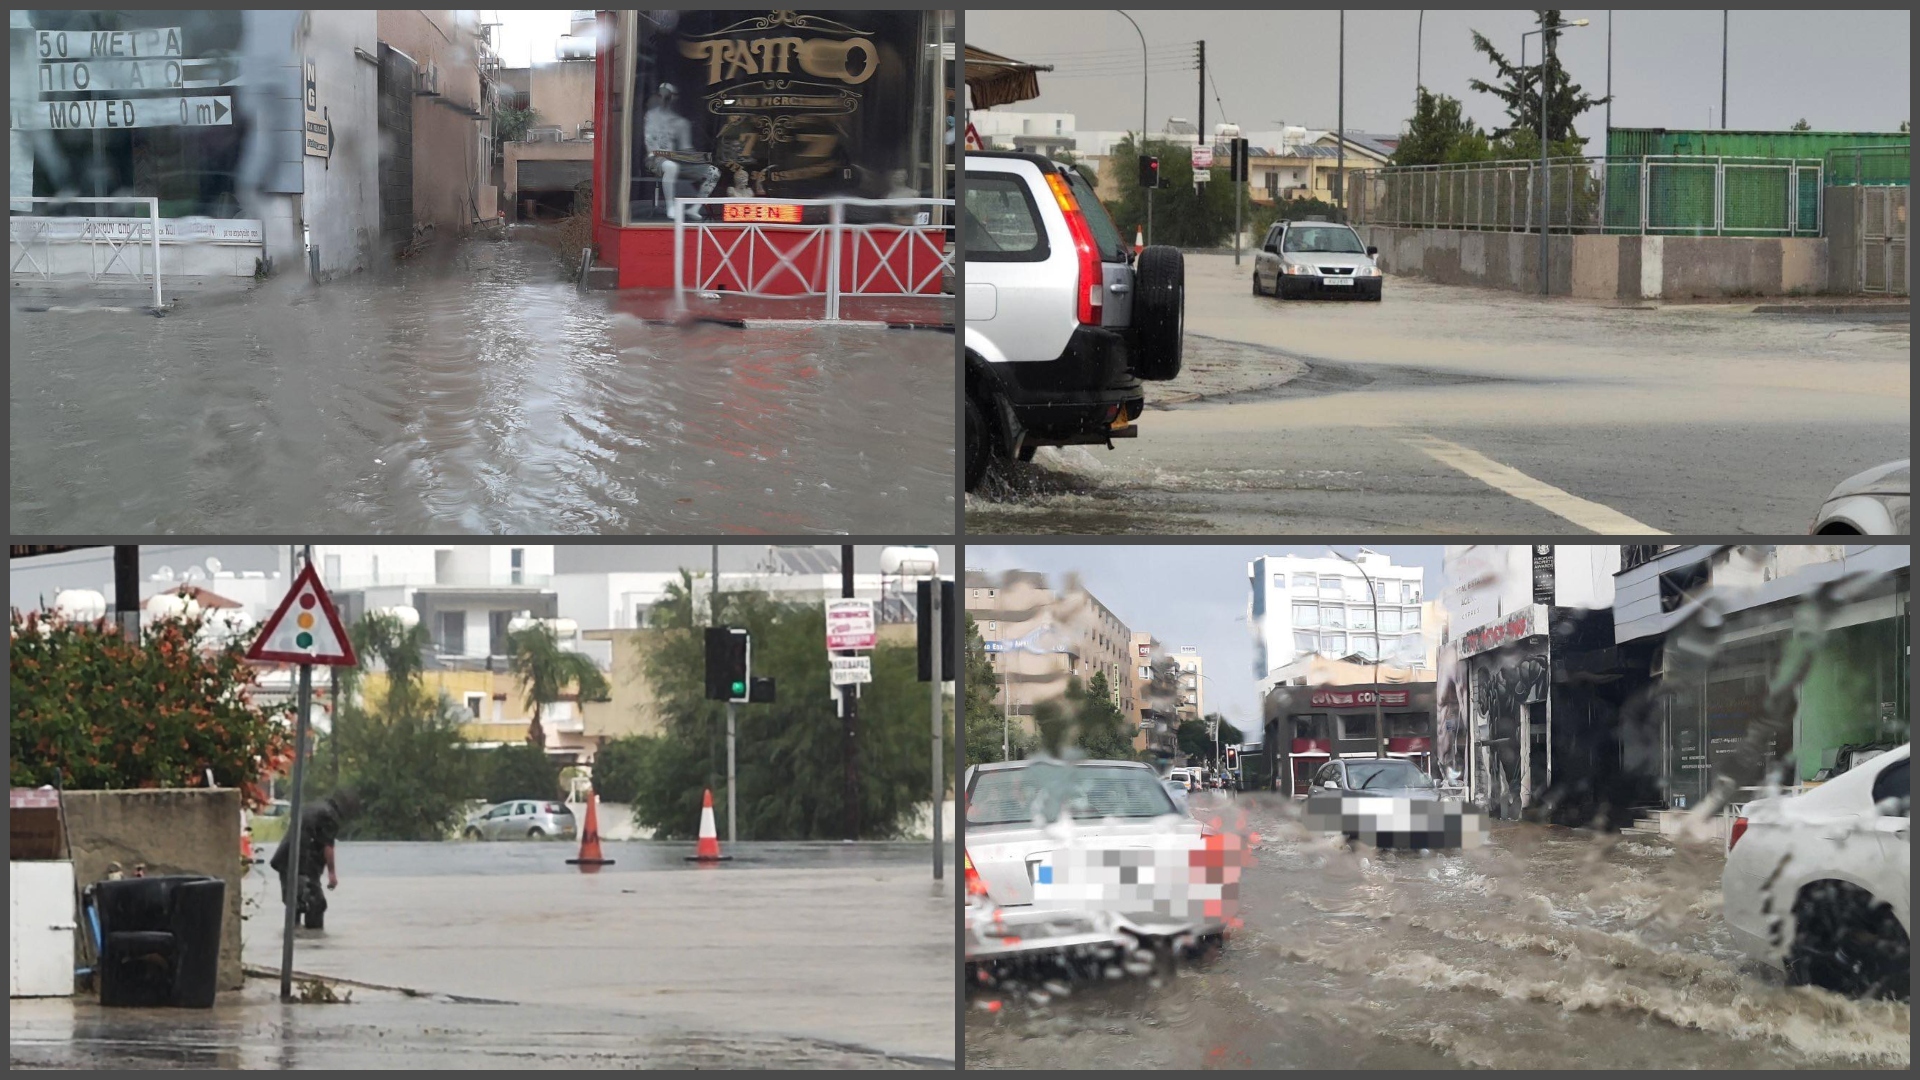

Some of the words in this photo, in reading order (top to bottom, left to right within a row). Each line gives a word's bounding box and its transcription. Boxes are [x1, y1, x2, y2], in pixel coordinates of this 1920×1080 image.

[39, 31, 67, 58] 50
[680, 37, 880, 86] TATTO
[38, 63, 90, 91] ΠΙΟ
[108, 60, 182, 89] ΑΩ
[50, 100, 136, 128] MOVED
[729, 206, 780, 219] OPEN
[1357, 691, 1406, 703] COFF
